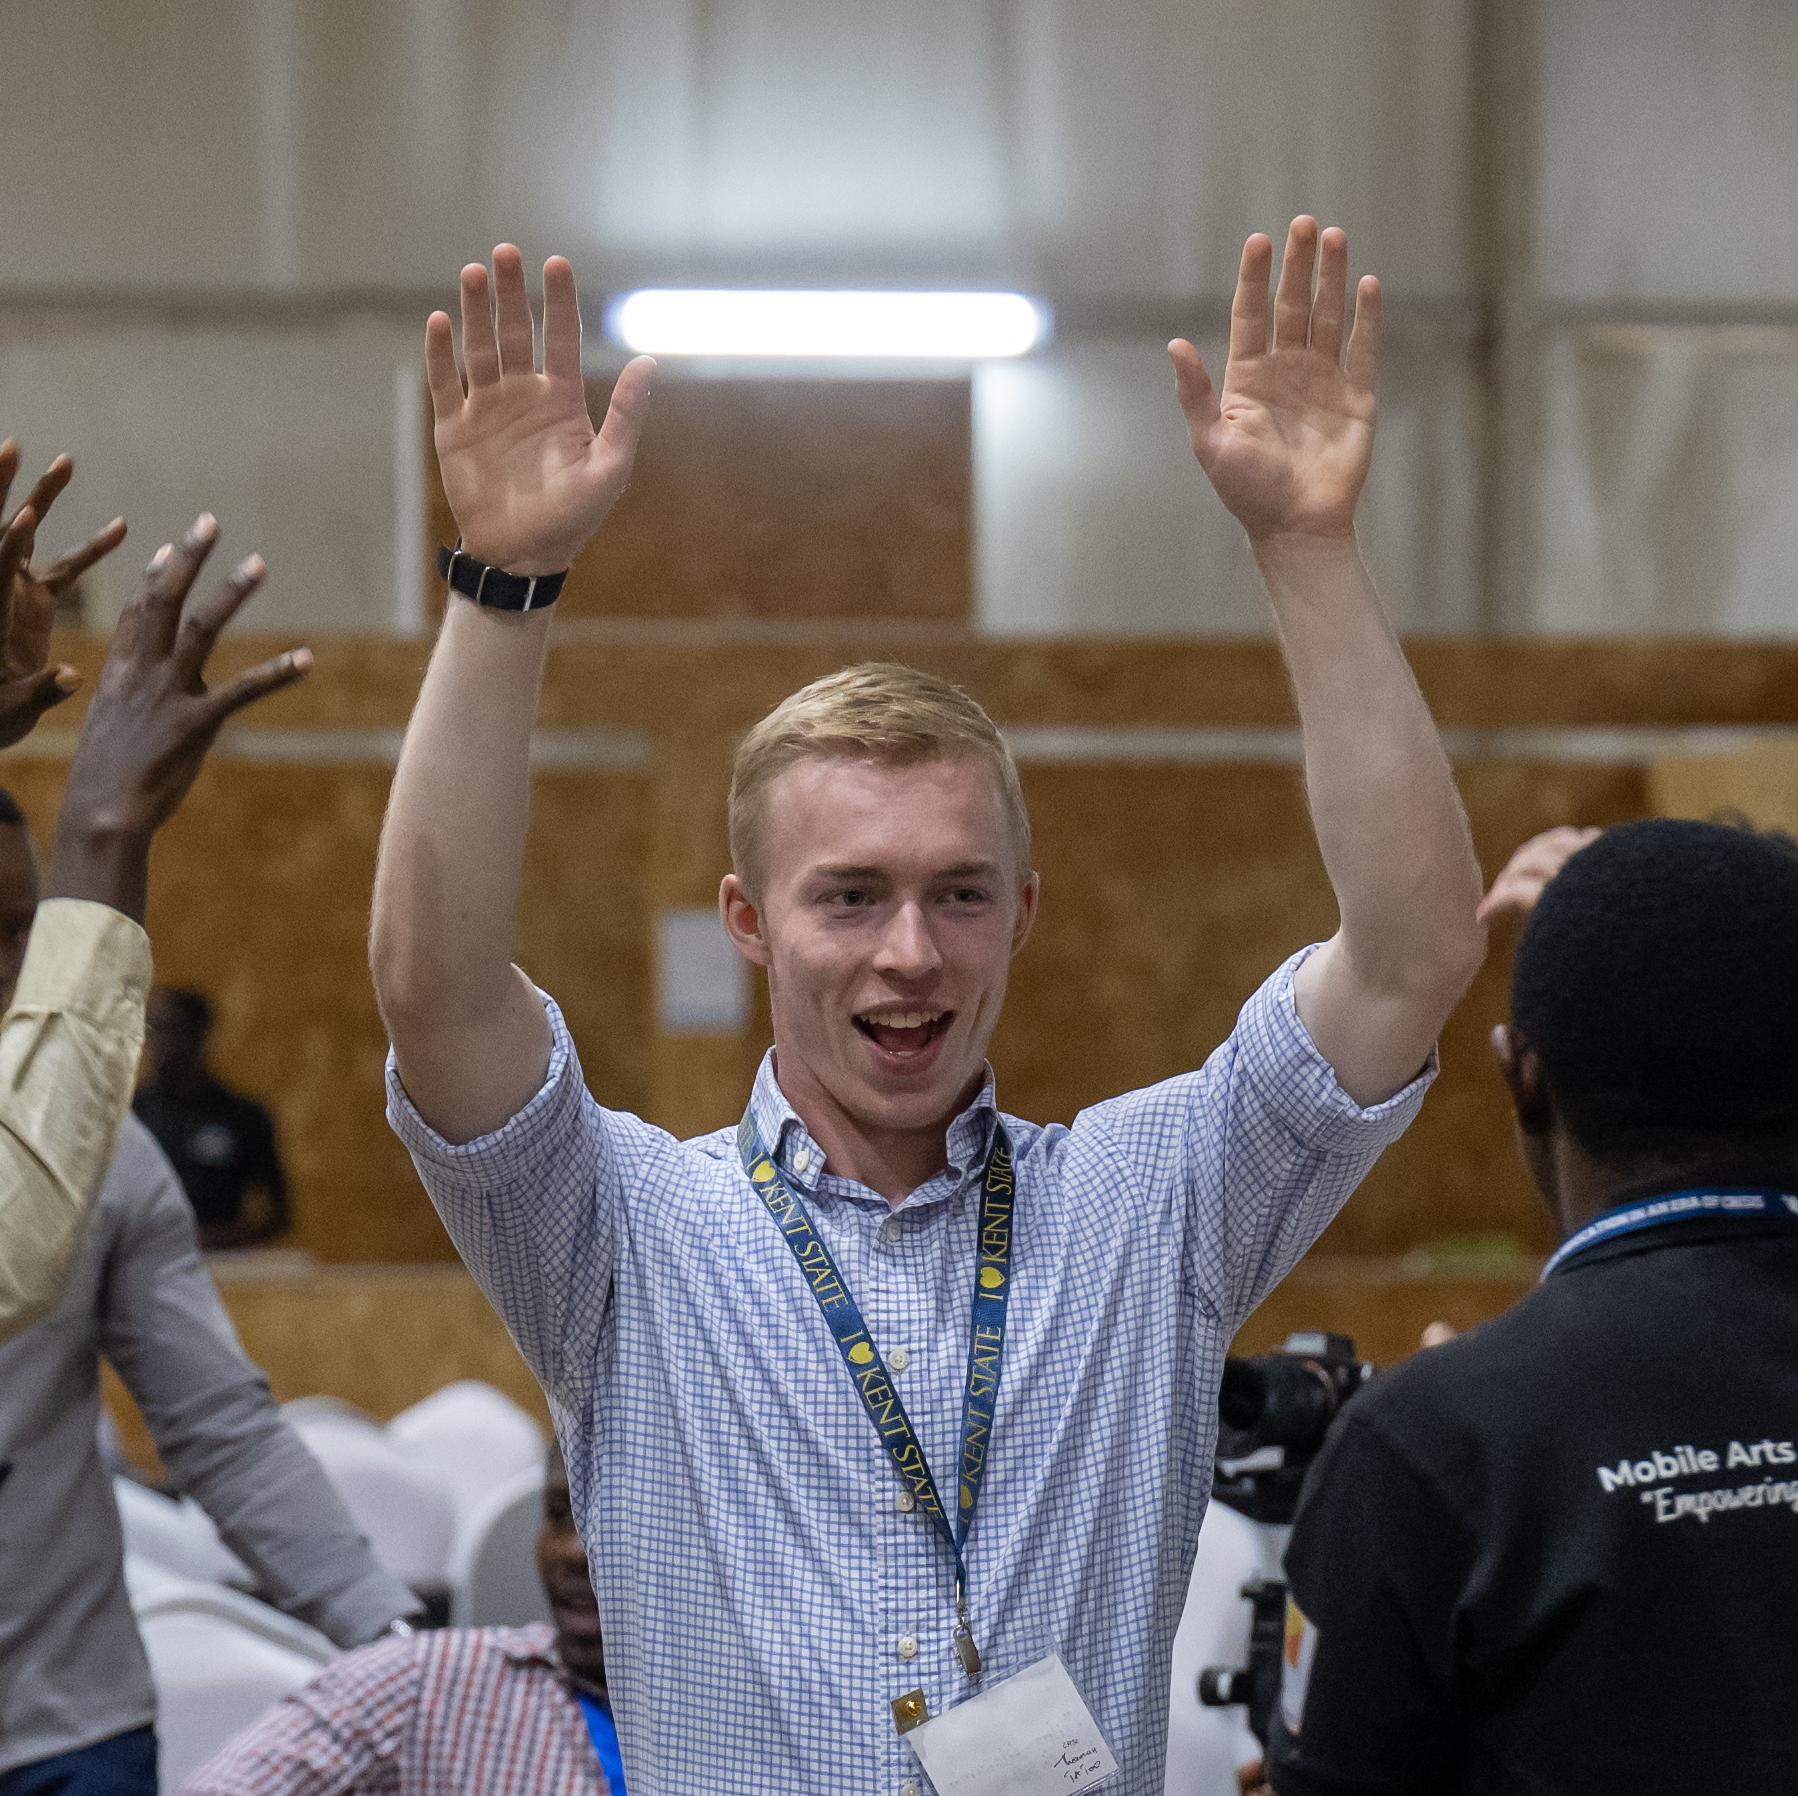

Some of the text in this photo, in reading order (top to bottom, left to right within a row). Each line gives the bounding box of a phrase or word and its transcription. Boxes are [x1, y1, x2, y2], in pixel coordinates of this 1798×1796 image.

[746, 1151, 850, 1313] I KENT STATE
[981, 1196, 1012, 1265] KENT
[979, 1291, 1005, 1302] I
[840, 1328, 865, 1343] I
[856, 1364, 912, 1437] KENT
[969, 1323, 1002, 1403] STATE
[961, 1401, 991, 1484] KENT
[1596, 1443, 1721, 1493] Mobile
[1725, 1439, 1797, 1470] Arts
